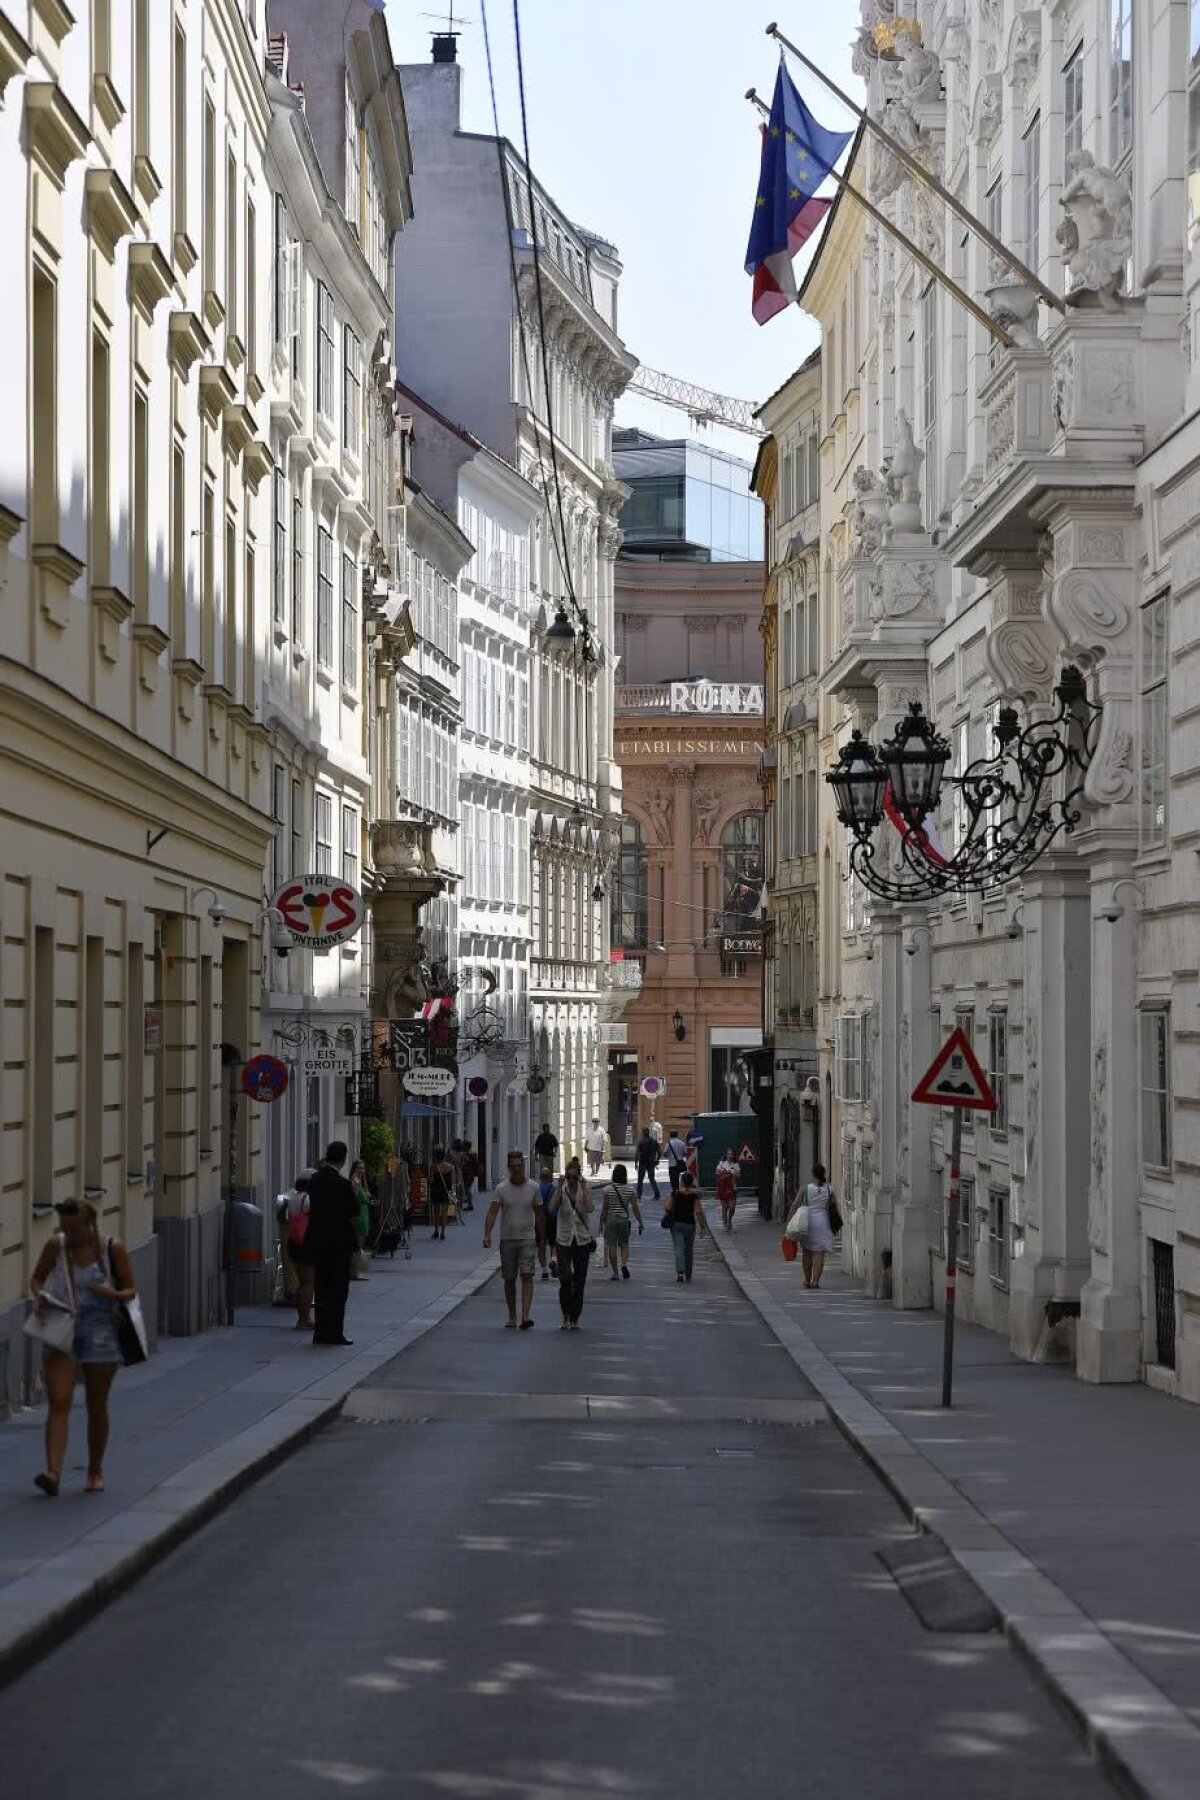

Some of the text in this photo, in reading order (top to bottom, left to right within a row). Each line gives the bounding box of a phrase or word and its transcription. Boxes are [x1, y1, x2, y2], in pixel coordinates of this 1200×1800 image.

[287, 929, 344, 946] ONTANIVE
[317, 1050, 336, 1059] EIS
[304, 1060, 350, 1070] GROTTE
